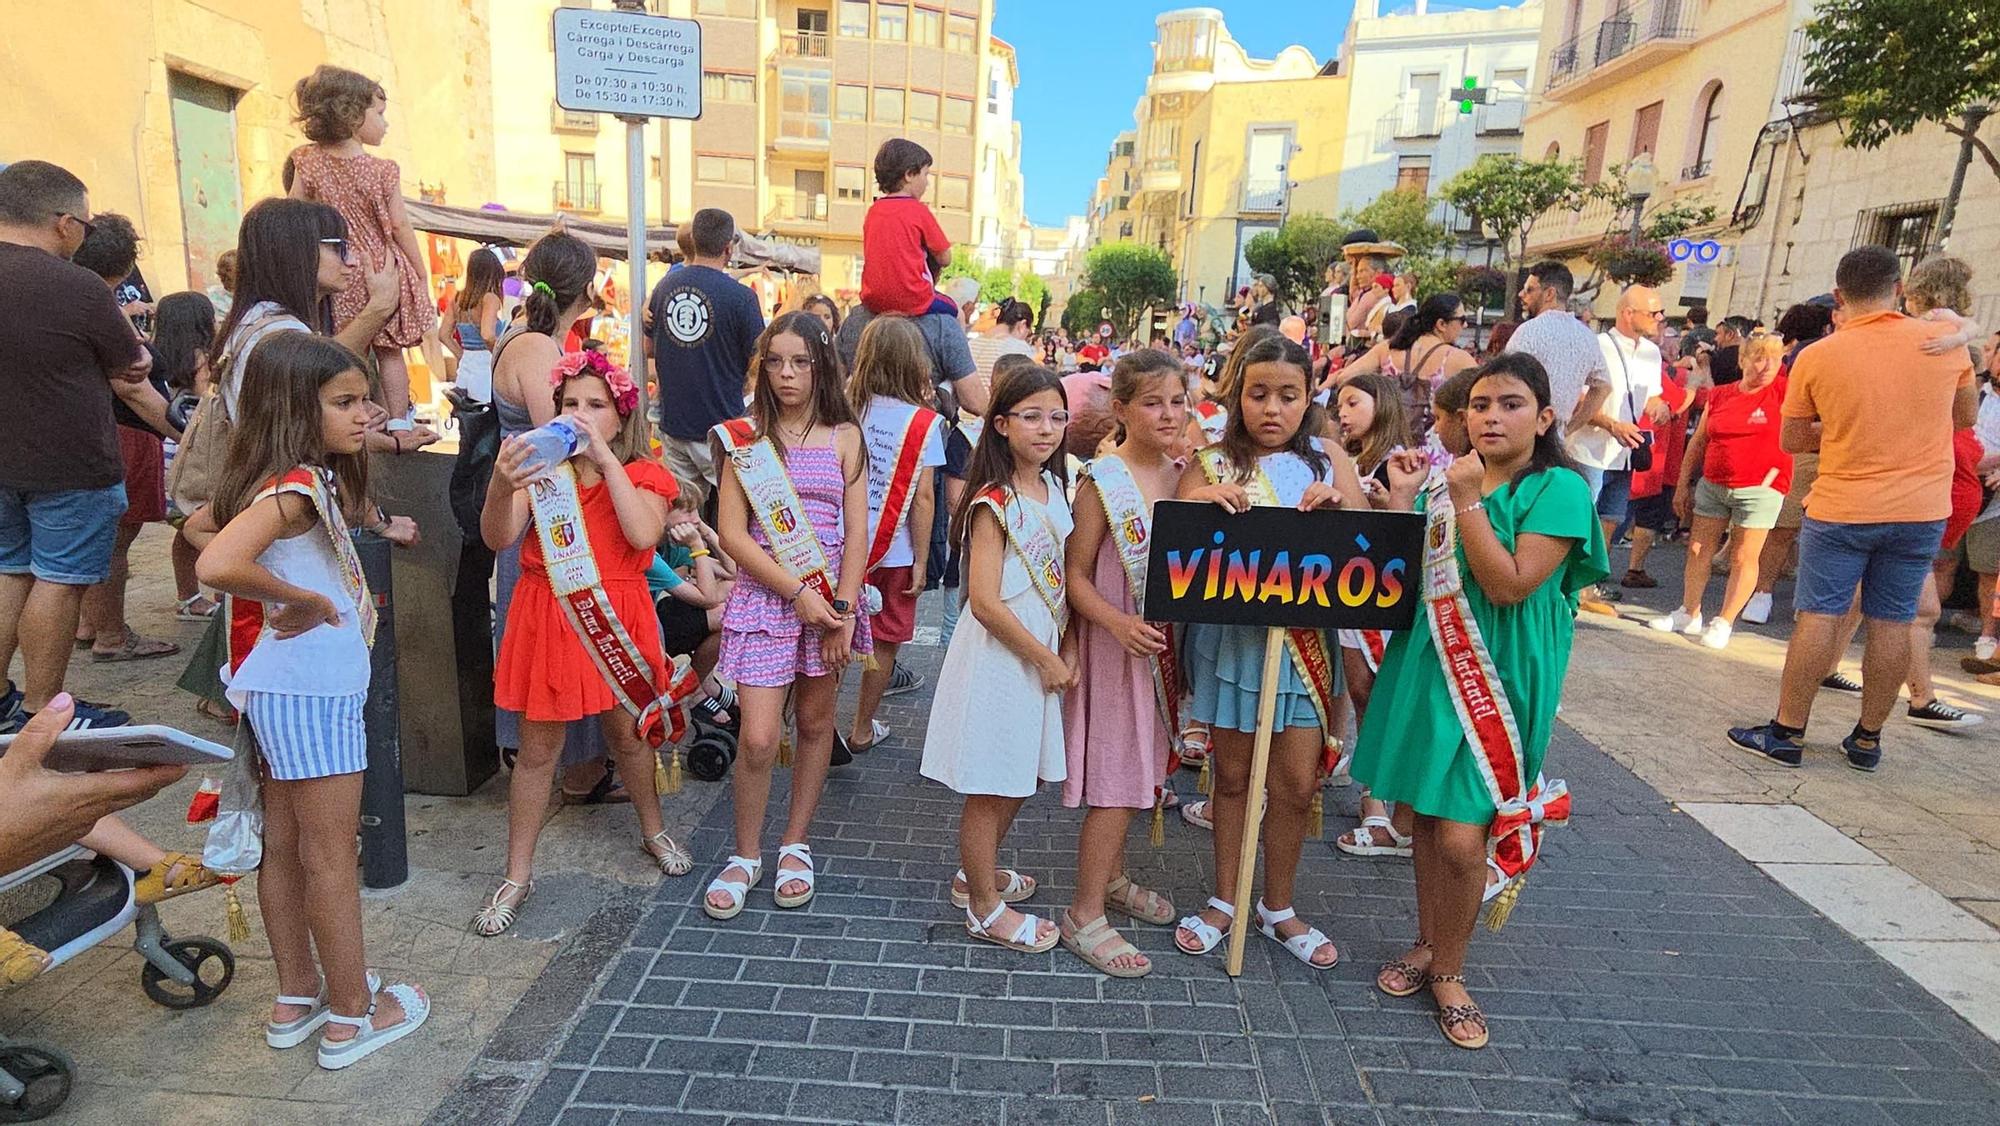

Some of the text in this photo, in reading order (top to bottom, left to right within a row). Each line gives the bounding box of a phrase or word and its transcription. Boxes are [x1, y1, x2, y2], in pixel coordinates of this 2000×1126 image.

[580, 18, 682, 39] Excepte/Excepto
[577, 47, 685, 68] Carga y Descarga
[575, 74, 688, 95] De 07:30 a 10:30 h.
[575, 88, 688, 109] De 15:30 a 17:30 h.
[1166, 530, 1407, 609] VINARÒS
[574, 597, 638, 685] Dama Infantil
[1438, 602, 1498, 721] Dama Infantil
